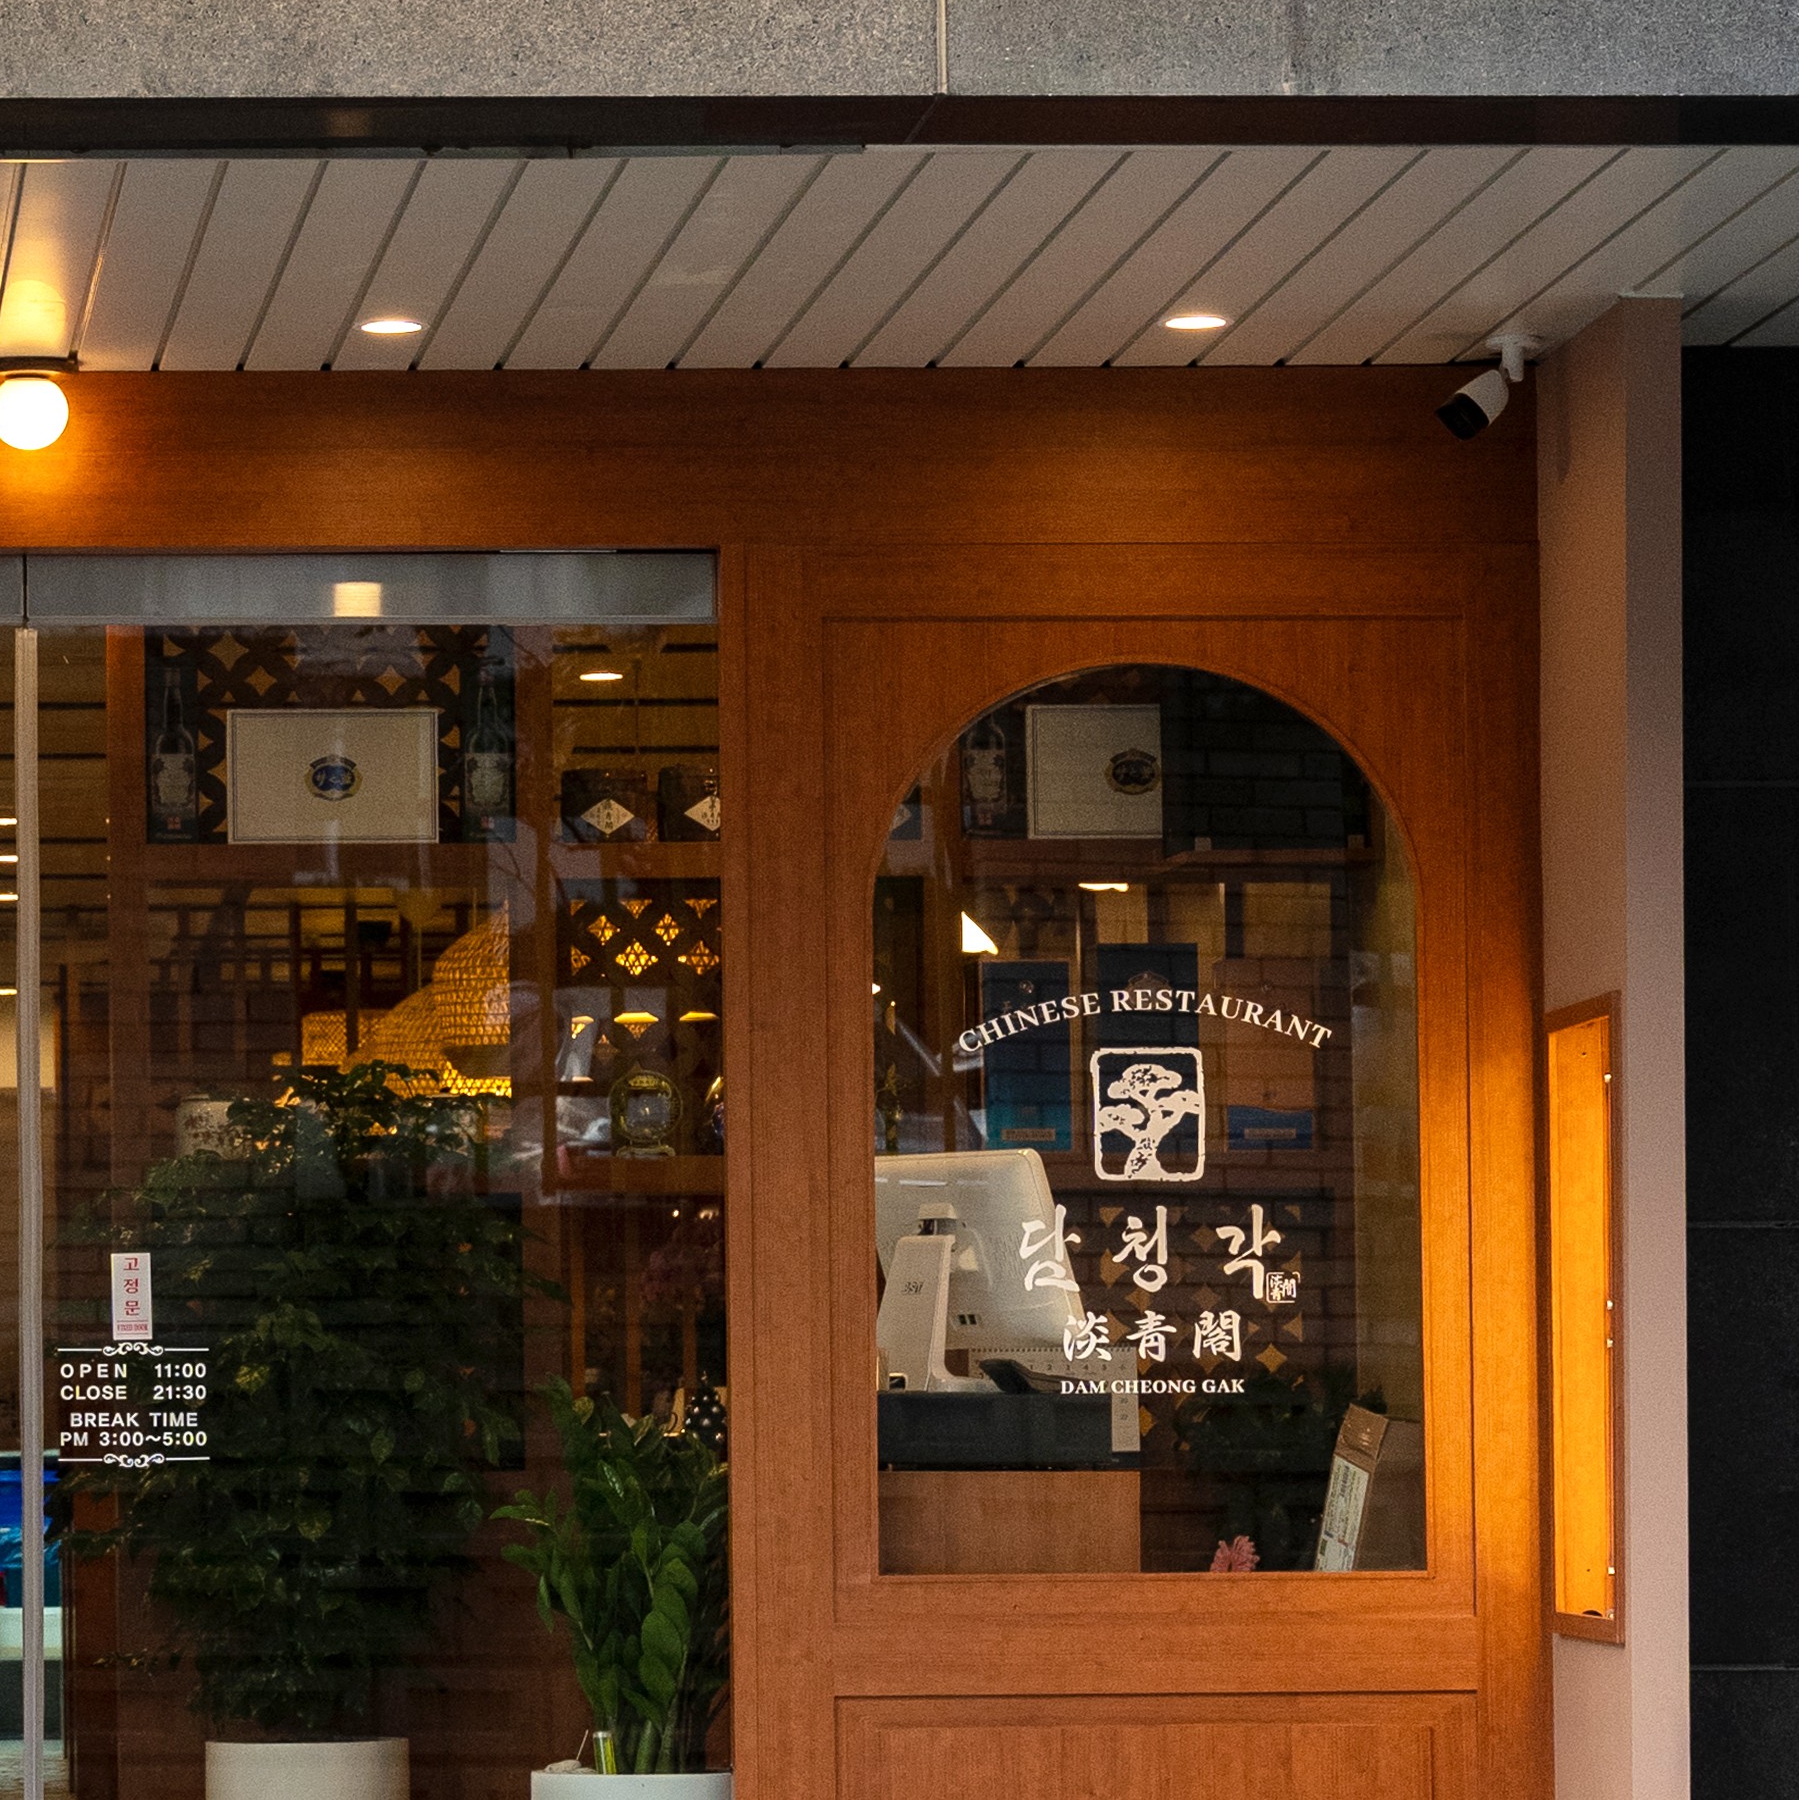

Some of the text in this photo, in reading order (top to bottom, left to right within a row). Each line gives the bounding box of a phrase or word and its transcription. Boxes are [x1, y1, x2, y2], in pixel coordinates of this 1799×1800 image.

[958, 988, 1333, 1053] CHINESE RESTAURANT
[123, 1257, 141, 1316] 고정문
[1063, 1309, 1241, 1363] 淡青閣
[60, 1363, 206, 1378] OPEN 11:00
[60, 1385, 207, 1400] CLOSE 21:30
[1060, 1379, 1245, 1394] DAM CHEONG GAK
[70, 1412, 198, 1427] BREAK TIME
[60, 1432, 88, 1446] PM
